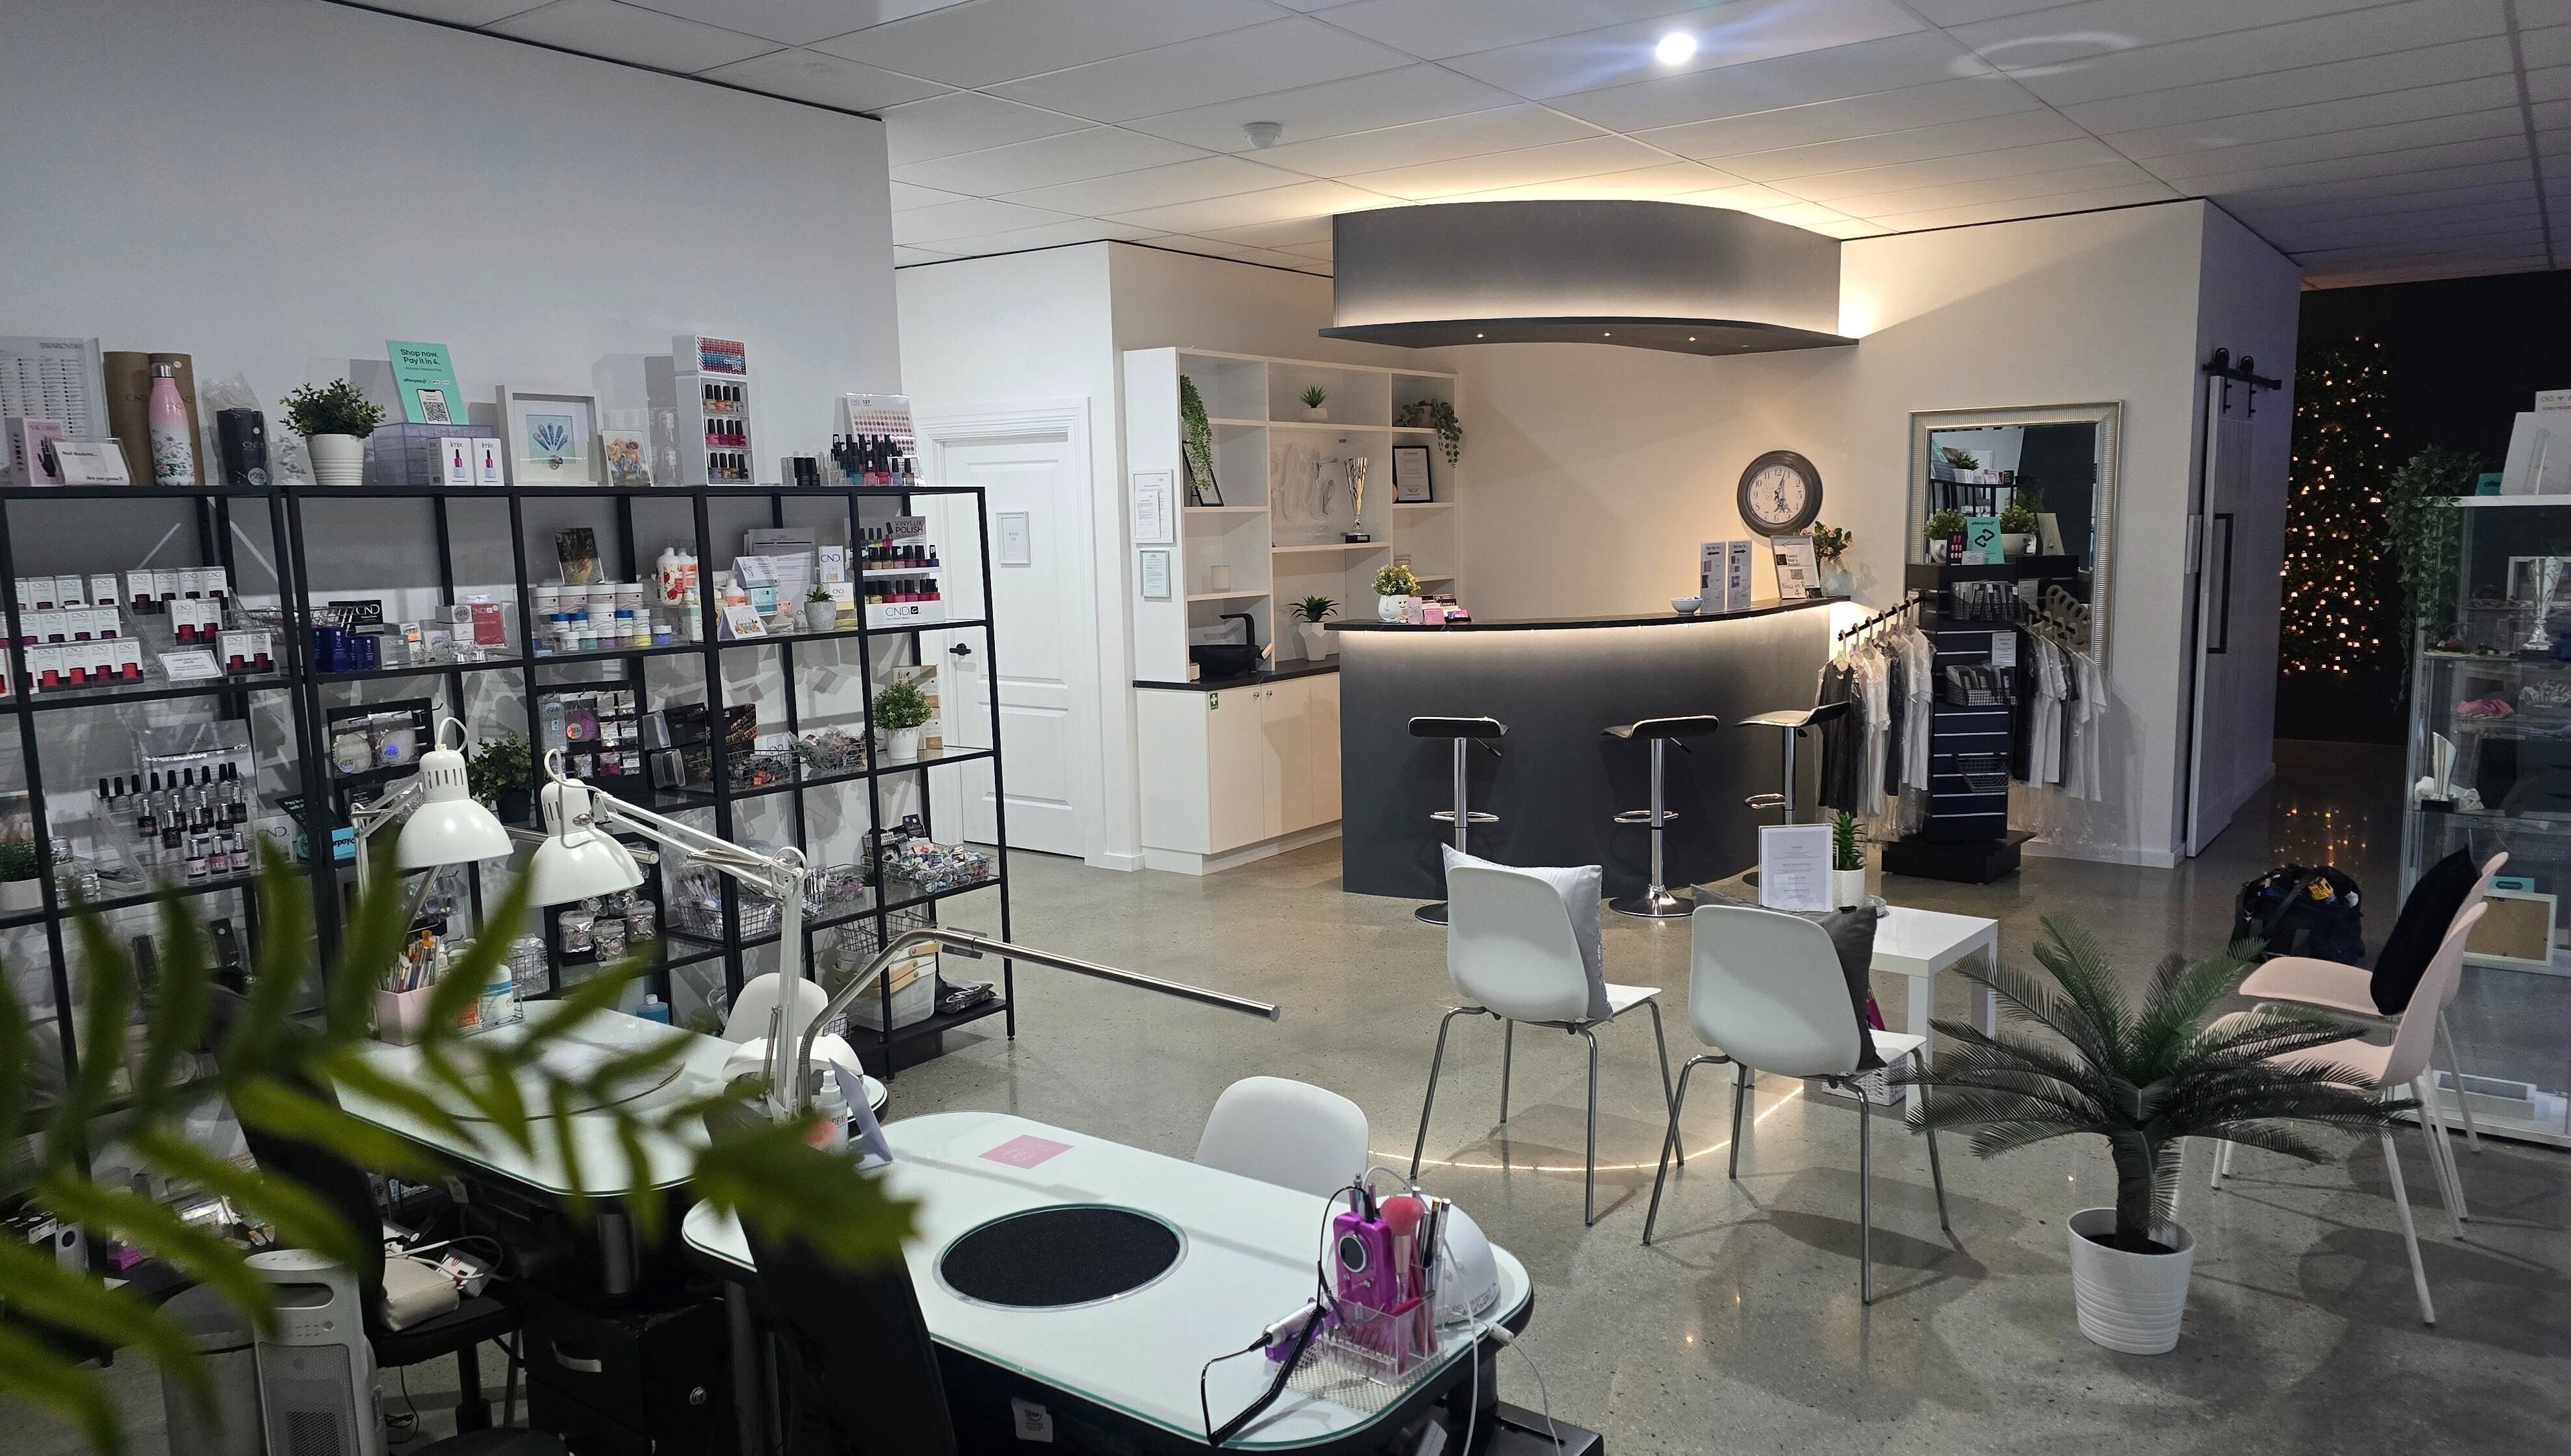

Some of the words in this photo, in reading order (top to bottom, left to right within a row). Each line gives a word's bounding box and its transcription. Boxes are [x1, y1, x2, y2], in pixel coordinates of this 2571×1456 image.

[400, 349, 420, 357] Shop
[404, 357, 418, 365] Pay
[1765, 471, 1770, 479] 11
[1796, 479, 1800, 487] 2
[1765, 511, 1769, 519] 7
[1774, 513, 1779, 521] 6
[820, 554, 841, 563] CND
[356, 604, 380, 615] CND
[885, 606, 911, 617] CND
